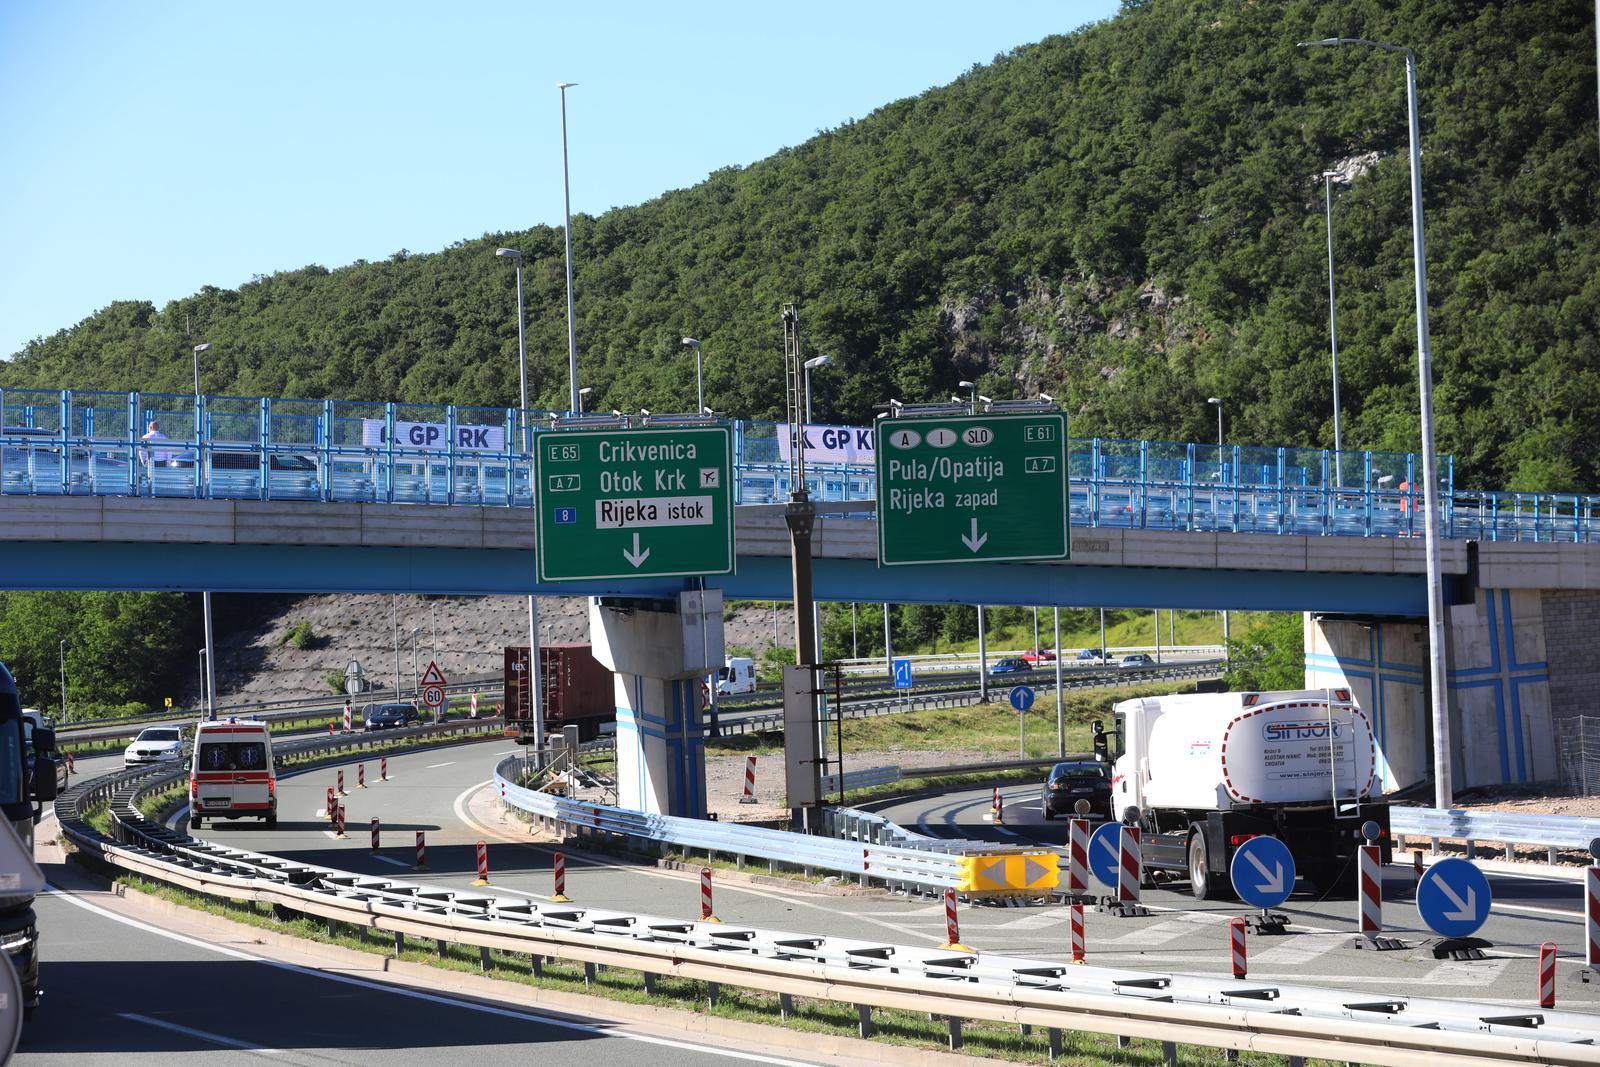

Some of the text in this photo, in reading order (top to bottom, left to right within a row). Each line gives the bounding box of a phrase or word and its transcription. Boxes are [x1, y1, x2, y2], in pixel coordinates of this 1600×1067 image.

[409, 425, 439, 446] GP
[822, 429, 875, 450] GP K
[901, 433, 909, 446] A
[968, 430, 988, 444] SLO
[1027, 427, 1050, 440] E 61
[551, 446, 577, 460] E 65
[599, 440, 697, 463] Crikvenica
[889, 455, 1004, 483] Pula/Opatija
[1032, 460, 1048, 471] A 7
[556, 477, 573, 489] A 7
[600, 469, 686, 493] Otok Krk
[890, 487, 998, 515] Rijeka zapad
[562, 509, 569, 521] 8
[601, 500, 704, 527] Rijeka istok
[511, 661, 526, 671] tex
[427, 691, 441, 702] 60
